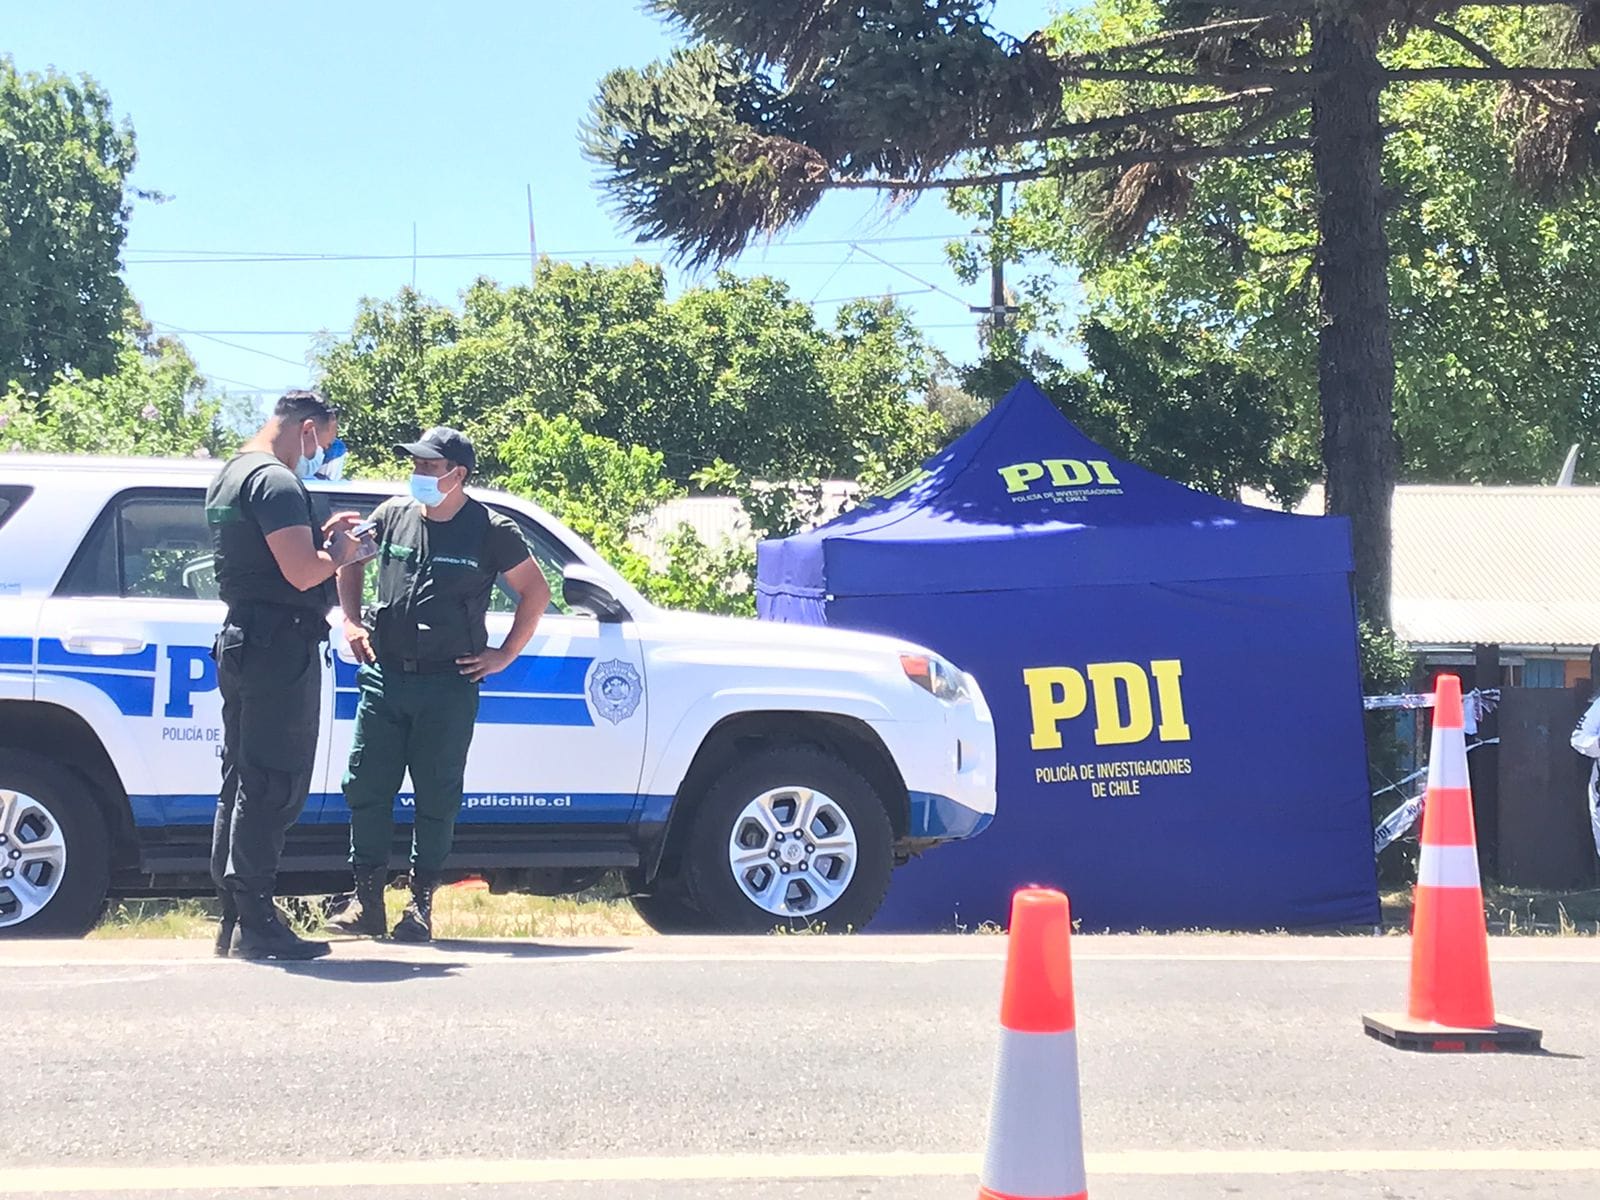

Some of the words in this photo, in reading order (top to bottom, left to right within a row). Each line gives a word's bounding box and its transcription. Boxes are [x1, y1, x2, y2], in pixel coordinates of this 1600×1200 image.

[998, 459, 1120, 493] PDI
[1023, 659, 1191, 750] PDI
[162, 725, 203, 741] POLICÍA
[206, 728, 220, 741] DE
[1036, 763, 1079, 783] POLICÍA
[1080, 764, 1095, 781] DE
[1097, 758, 1192, 779] INVESTIGACIONES
[1091, 782, 1107, 798] DE
[1108, 780, 1140, 797] CHILE
